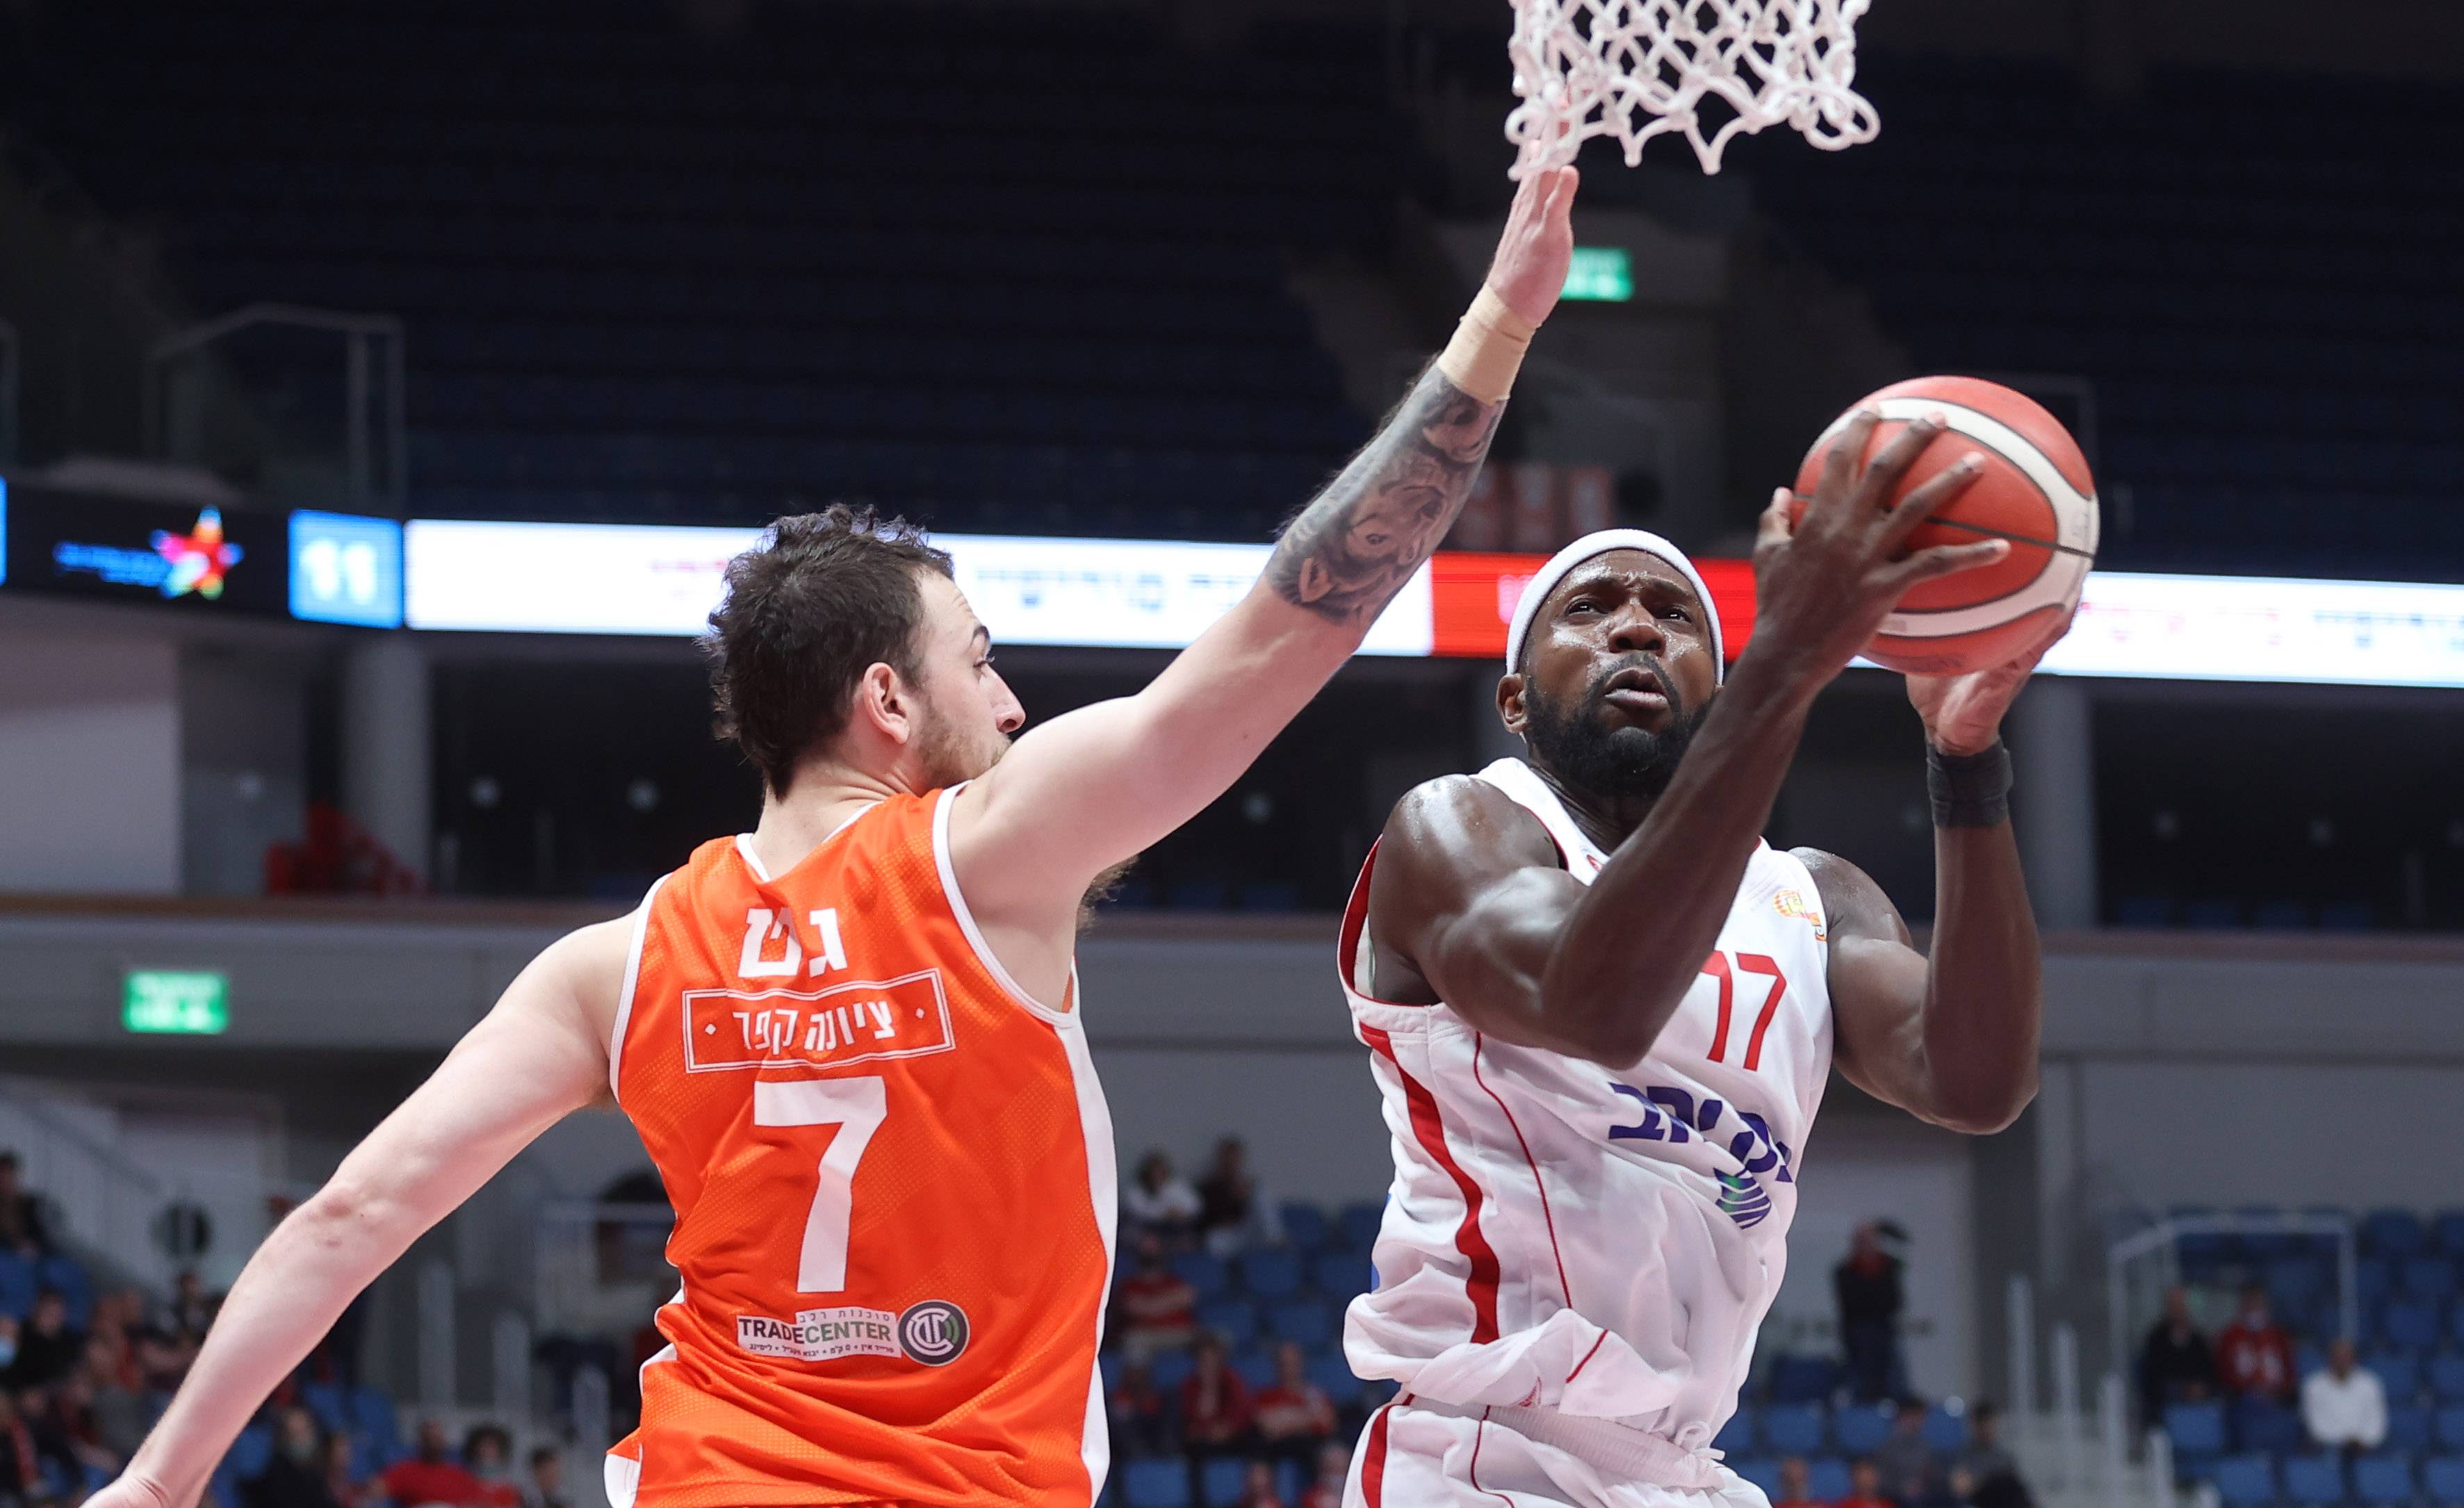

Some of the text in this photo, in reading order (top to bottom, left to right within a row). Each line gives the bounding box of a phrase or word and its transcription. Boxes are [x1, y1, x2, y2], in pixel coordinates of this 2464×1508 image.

[300, 538, 378, 605] 11
[737, 907, 849, 979] גט
[732, 1000, 897, 1055] ציונה קפר
[753, 1075, 888, 1294] 7
[799, 1308, 890, 1324] סוכנות רכב
